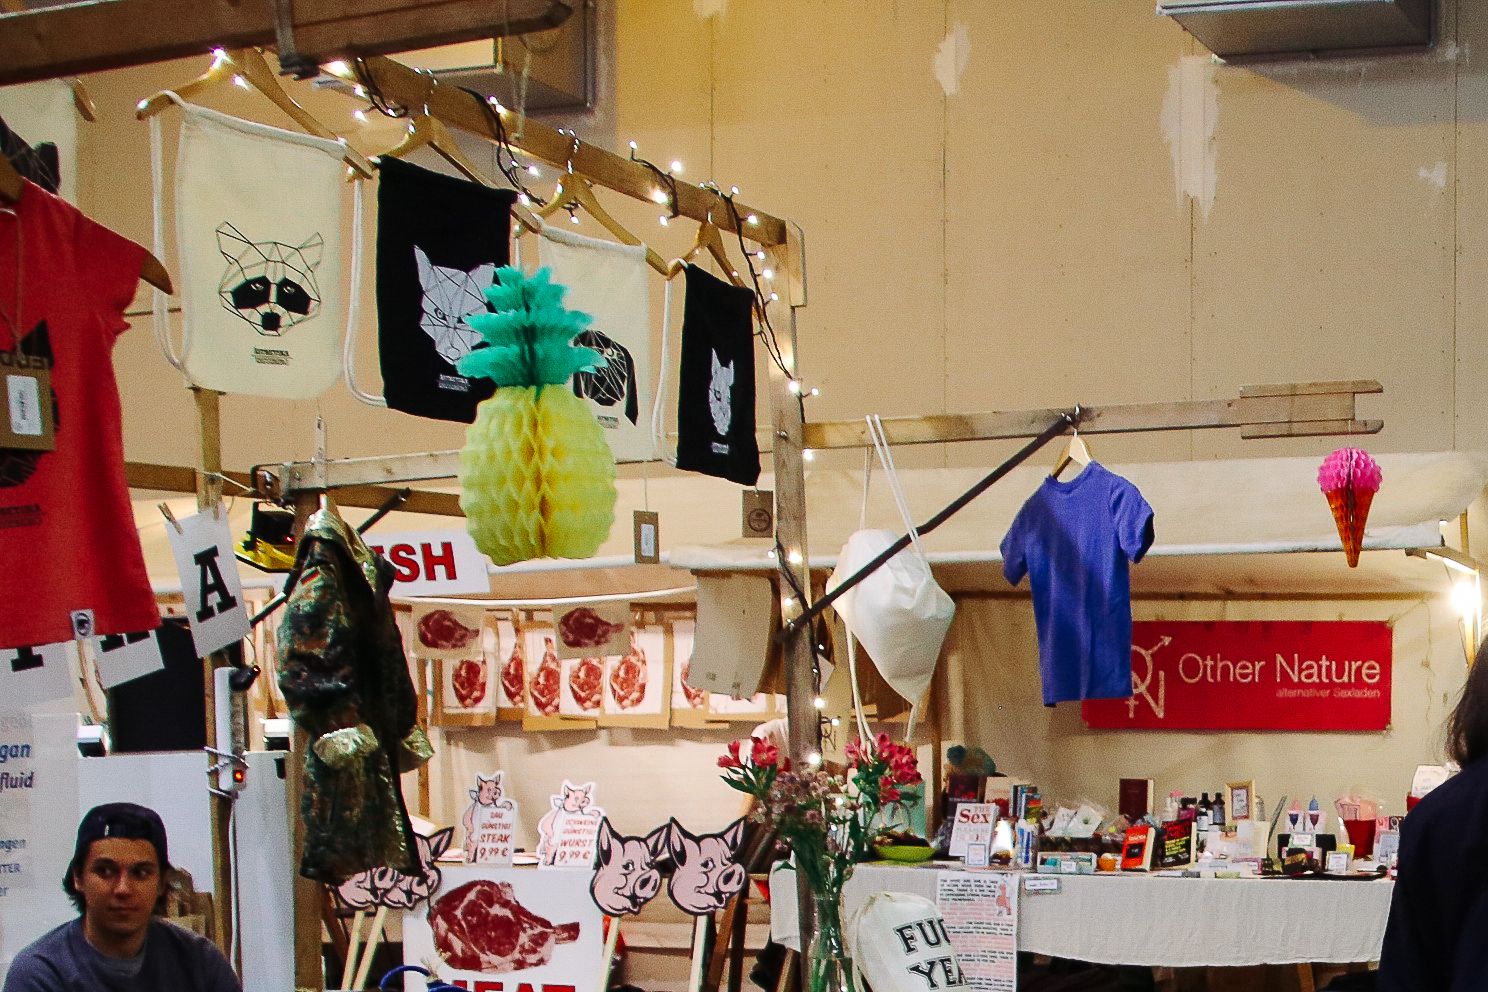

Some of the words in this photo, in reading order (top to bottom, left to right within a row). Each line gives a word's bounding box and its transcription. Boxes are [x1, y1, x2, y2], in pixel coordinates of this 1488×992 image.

[369, 541, 457, 583] SH
[193, 545, 238, 623] A
[1179, 652, 1266, 684] Other
[1275, 652, 1381, 684] Nature
[1275, 687, 1331, 698] alternativer
[958, 807, 990, 824] Sex
[480, 833, 511, 844] STEAK
